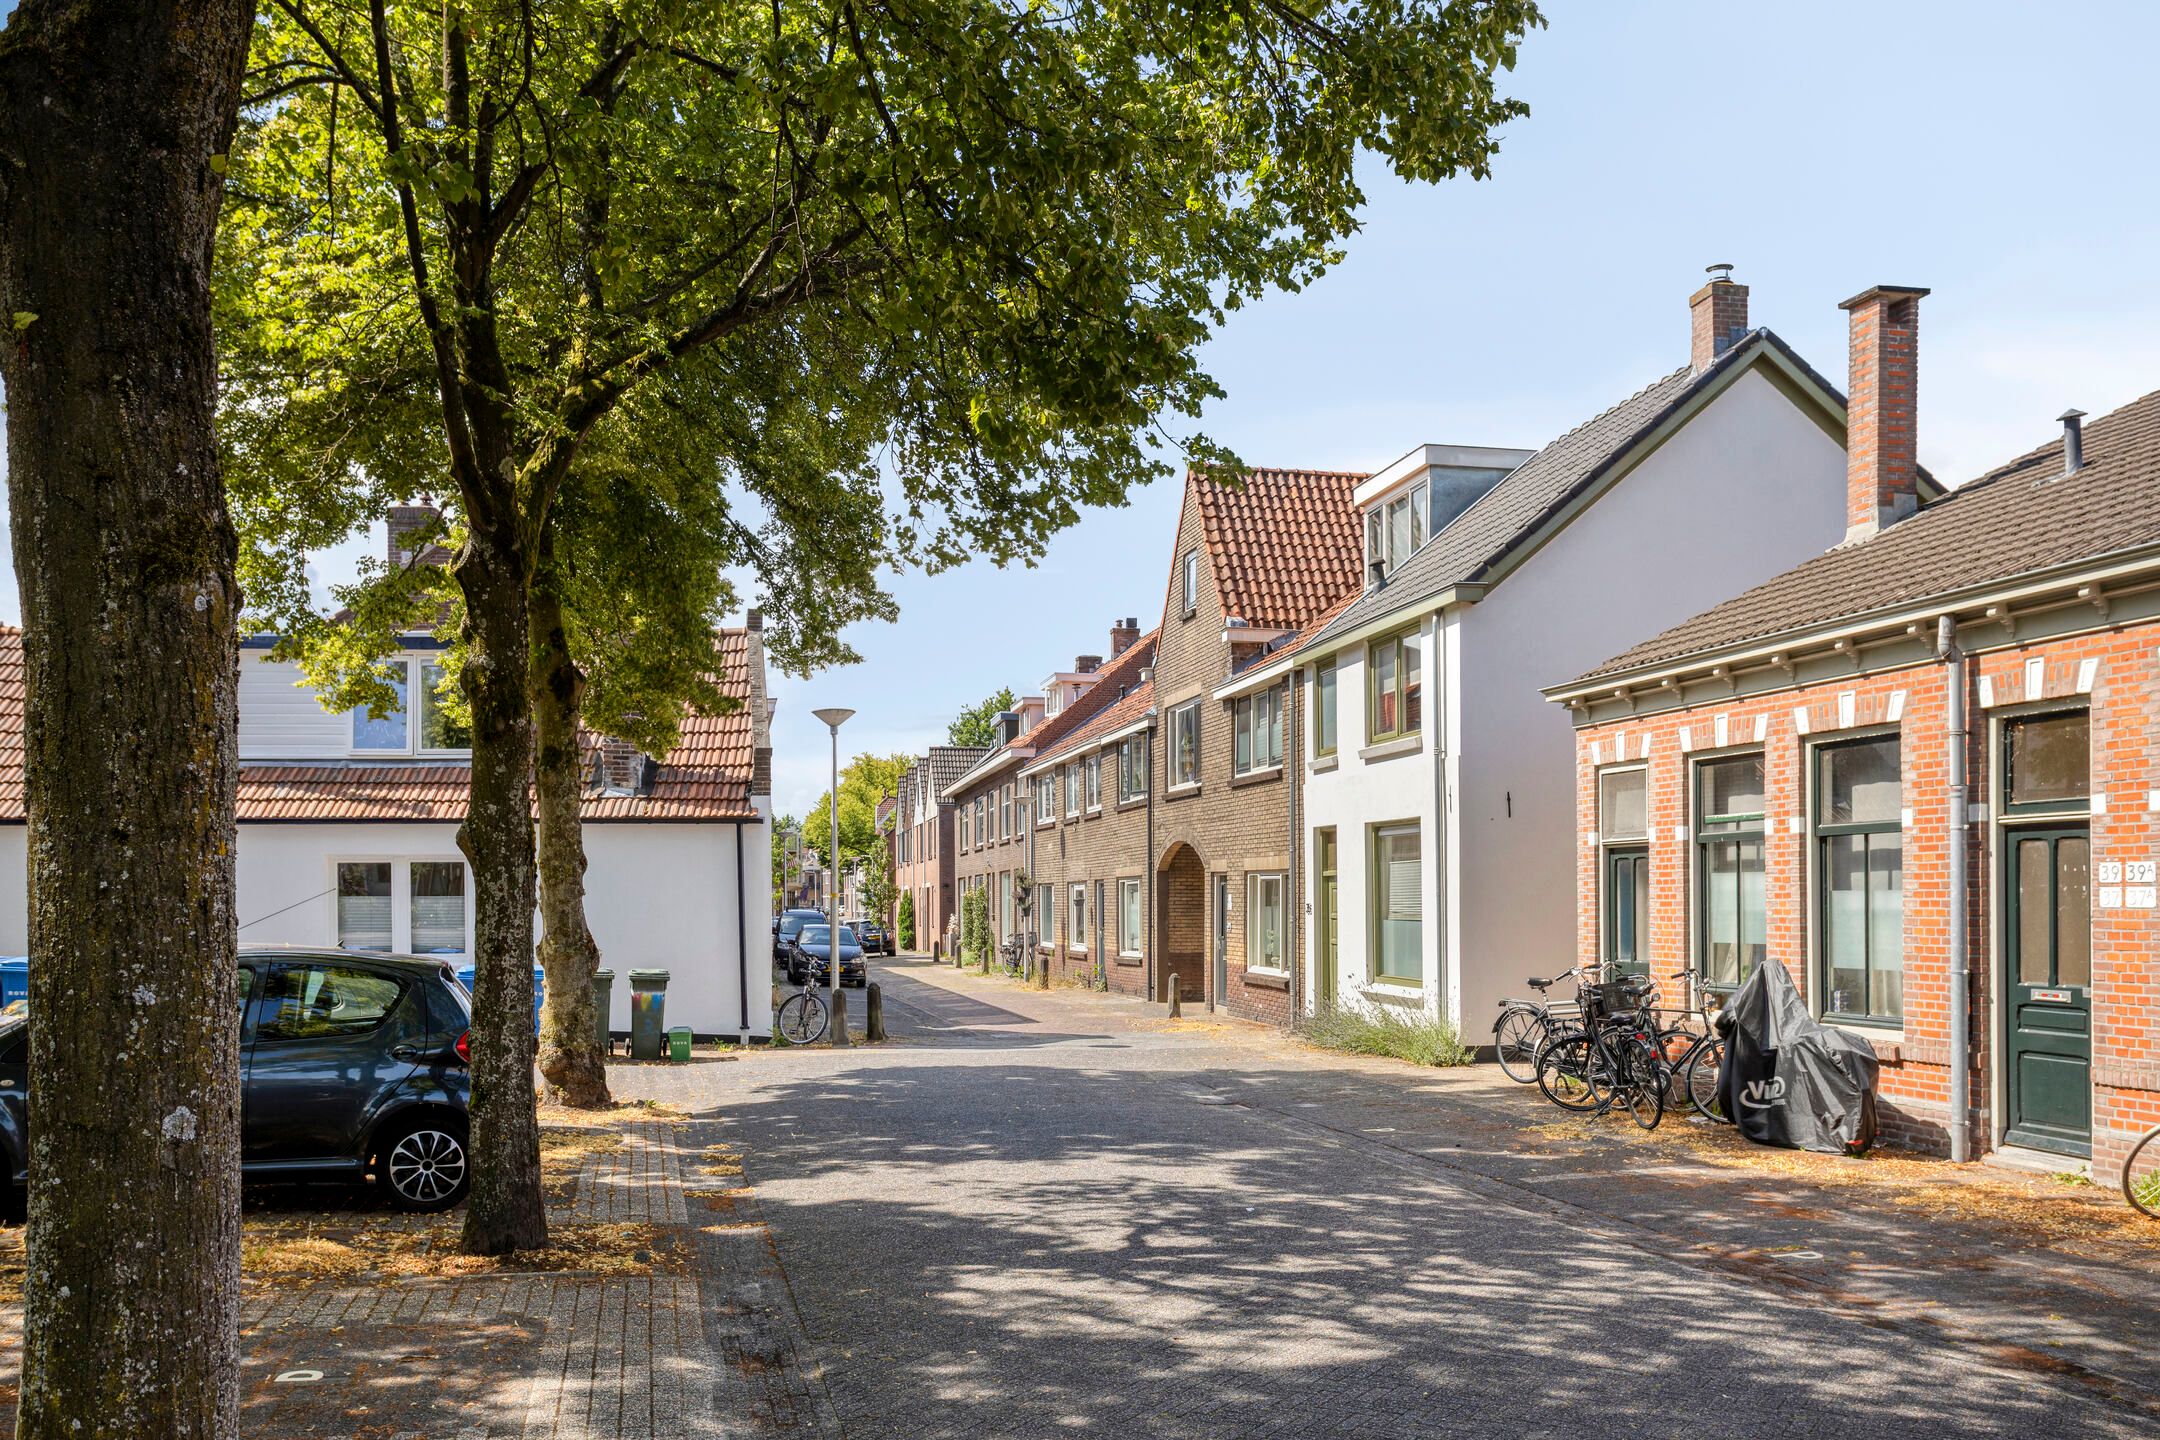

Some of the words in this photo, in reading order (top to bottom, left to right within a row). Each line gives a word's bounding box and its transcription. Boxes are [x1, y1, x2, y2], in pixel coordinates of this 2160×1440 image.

[2101, 865, 2120, 881] 39
[2127, 864, 2153, 881] 39A
[2102, 890, 2120, 906] 37
